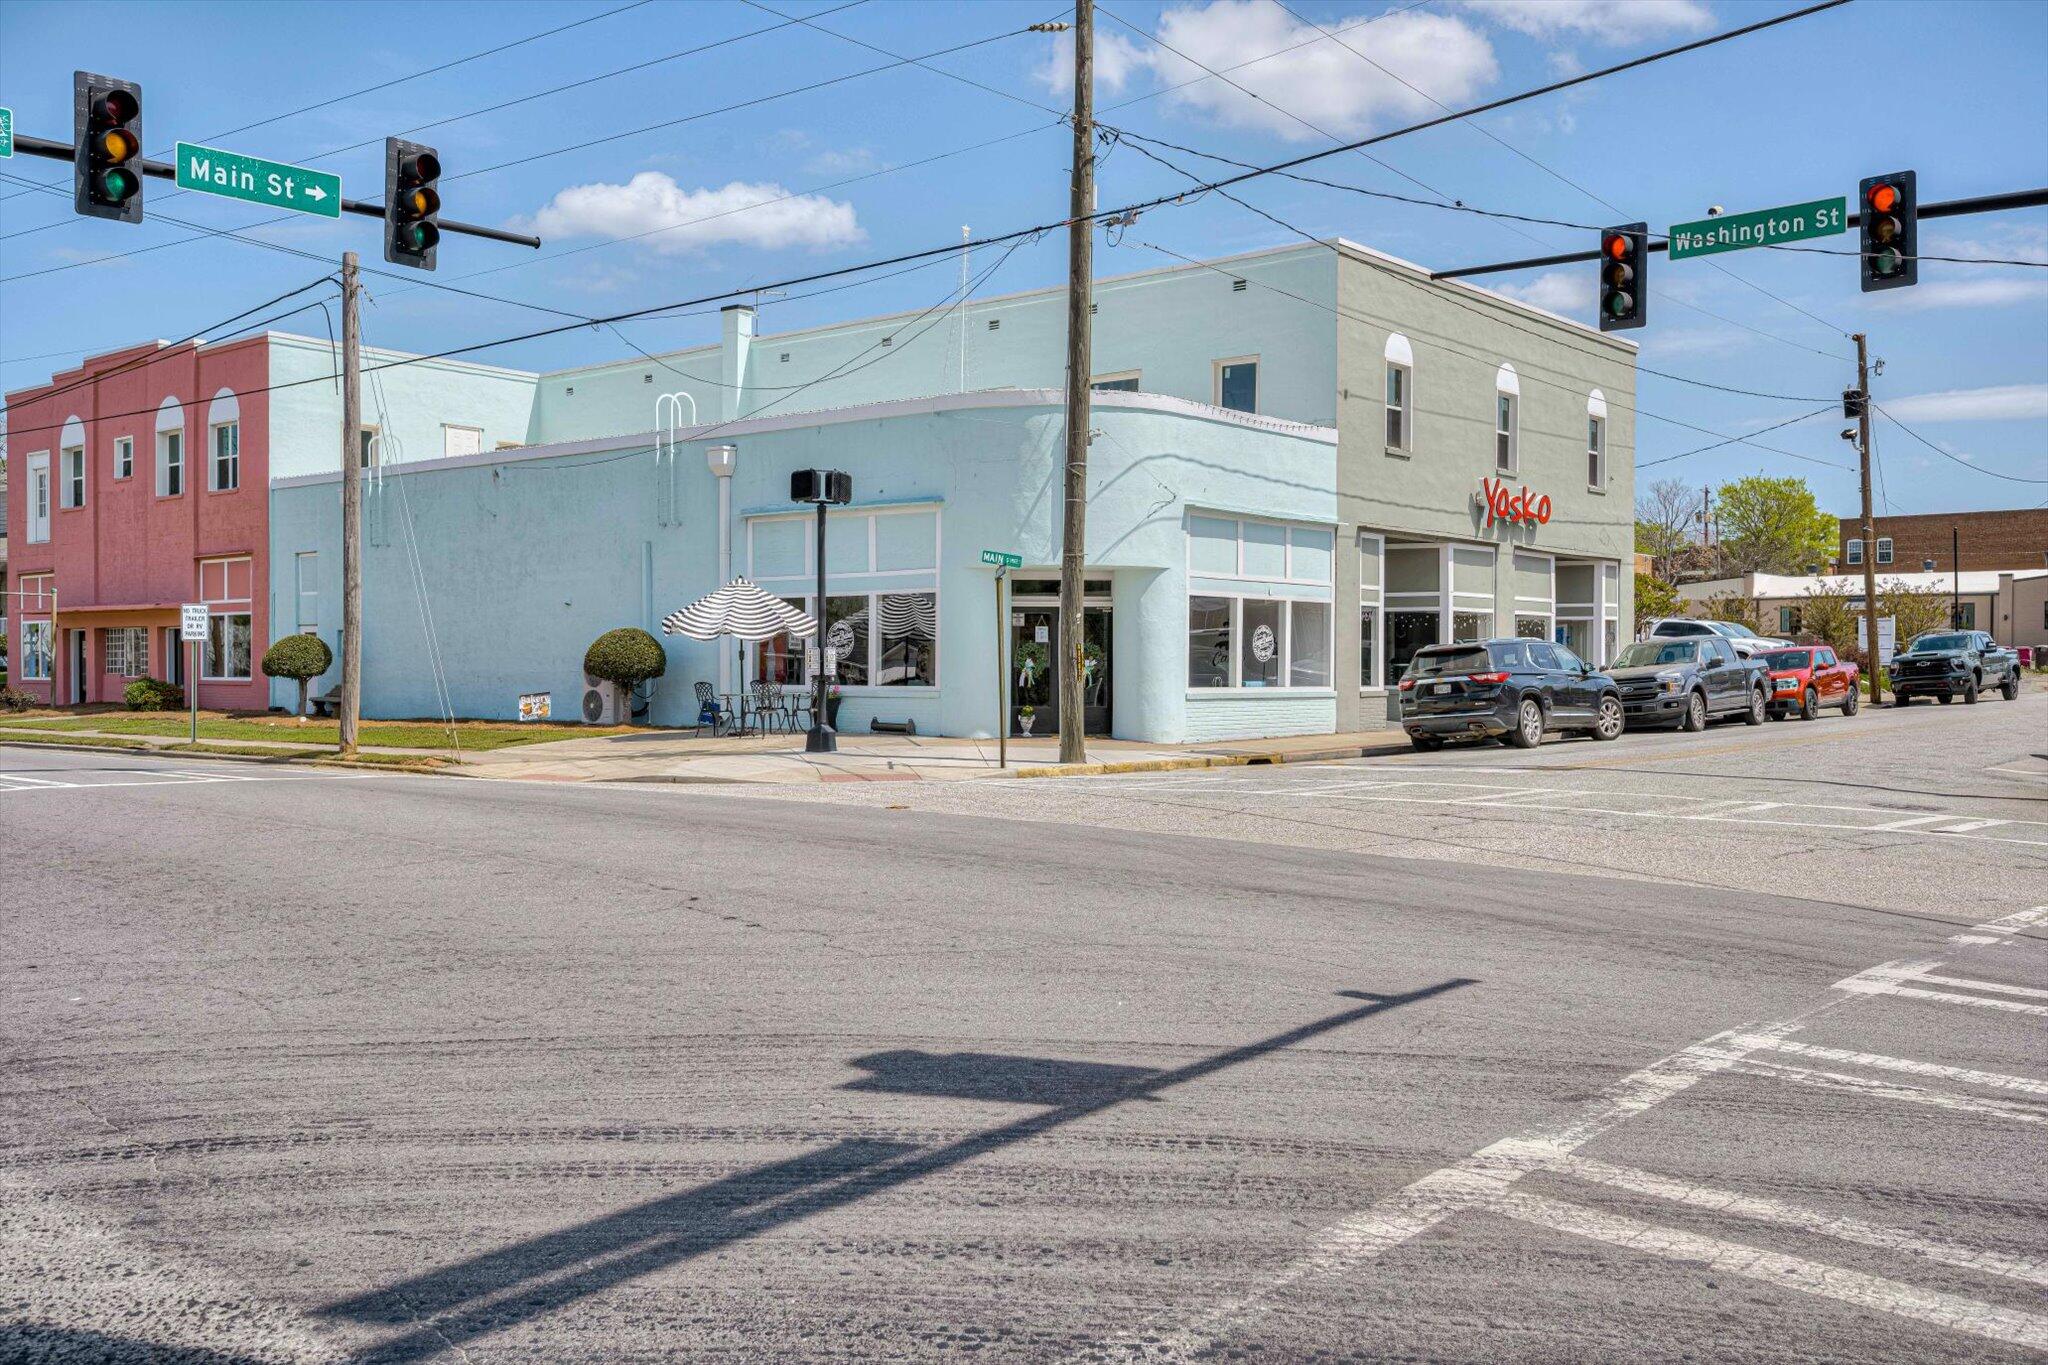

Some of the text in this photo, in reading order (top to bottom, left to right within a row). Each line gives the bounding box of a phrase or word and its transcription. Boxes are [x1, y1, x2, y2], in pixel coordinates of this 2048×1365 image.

[190, 156, 295, 199] Main St
[1675, 207, 1840, 252] Washington St
[983, 551, 1004, 564] MAIN
